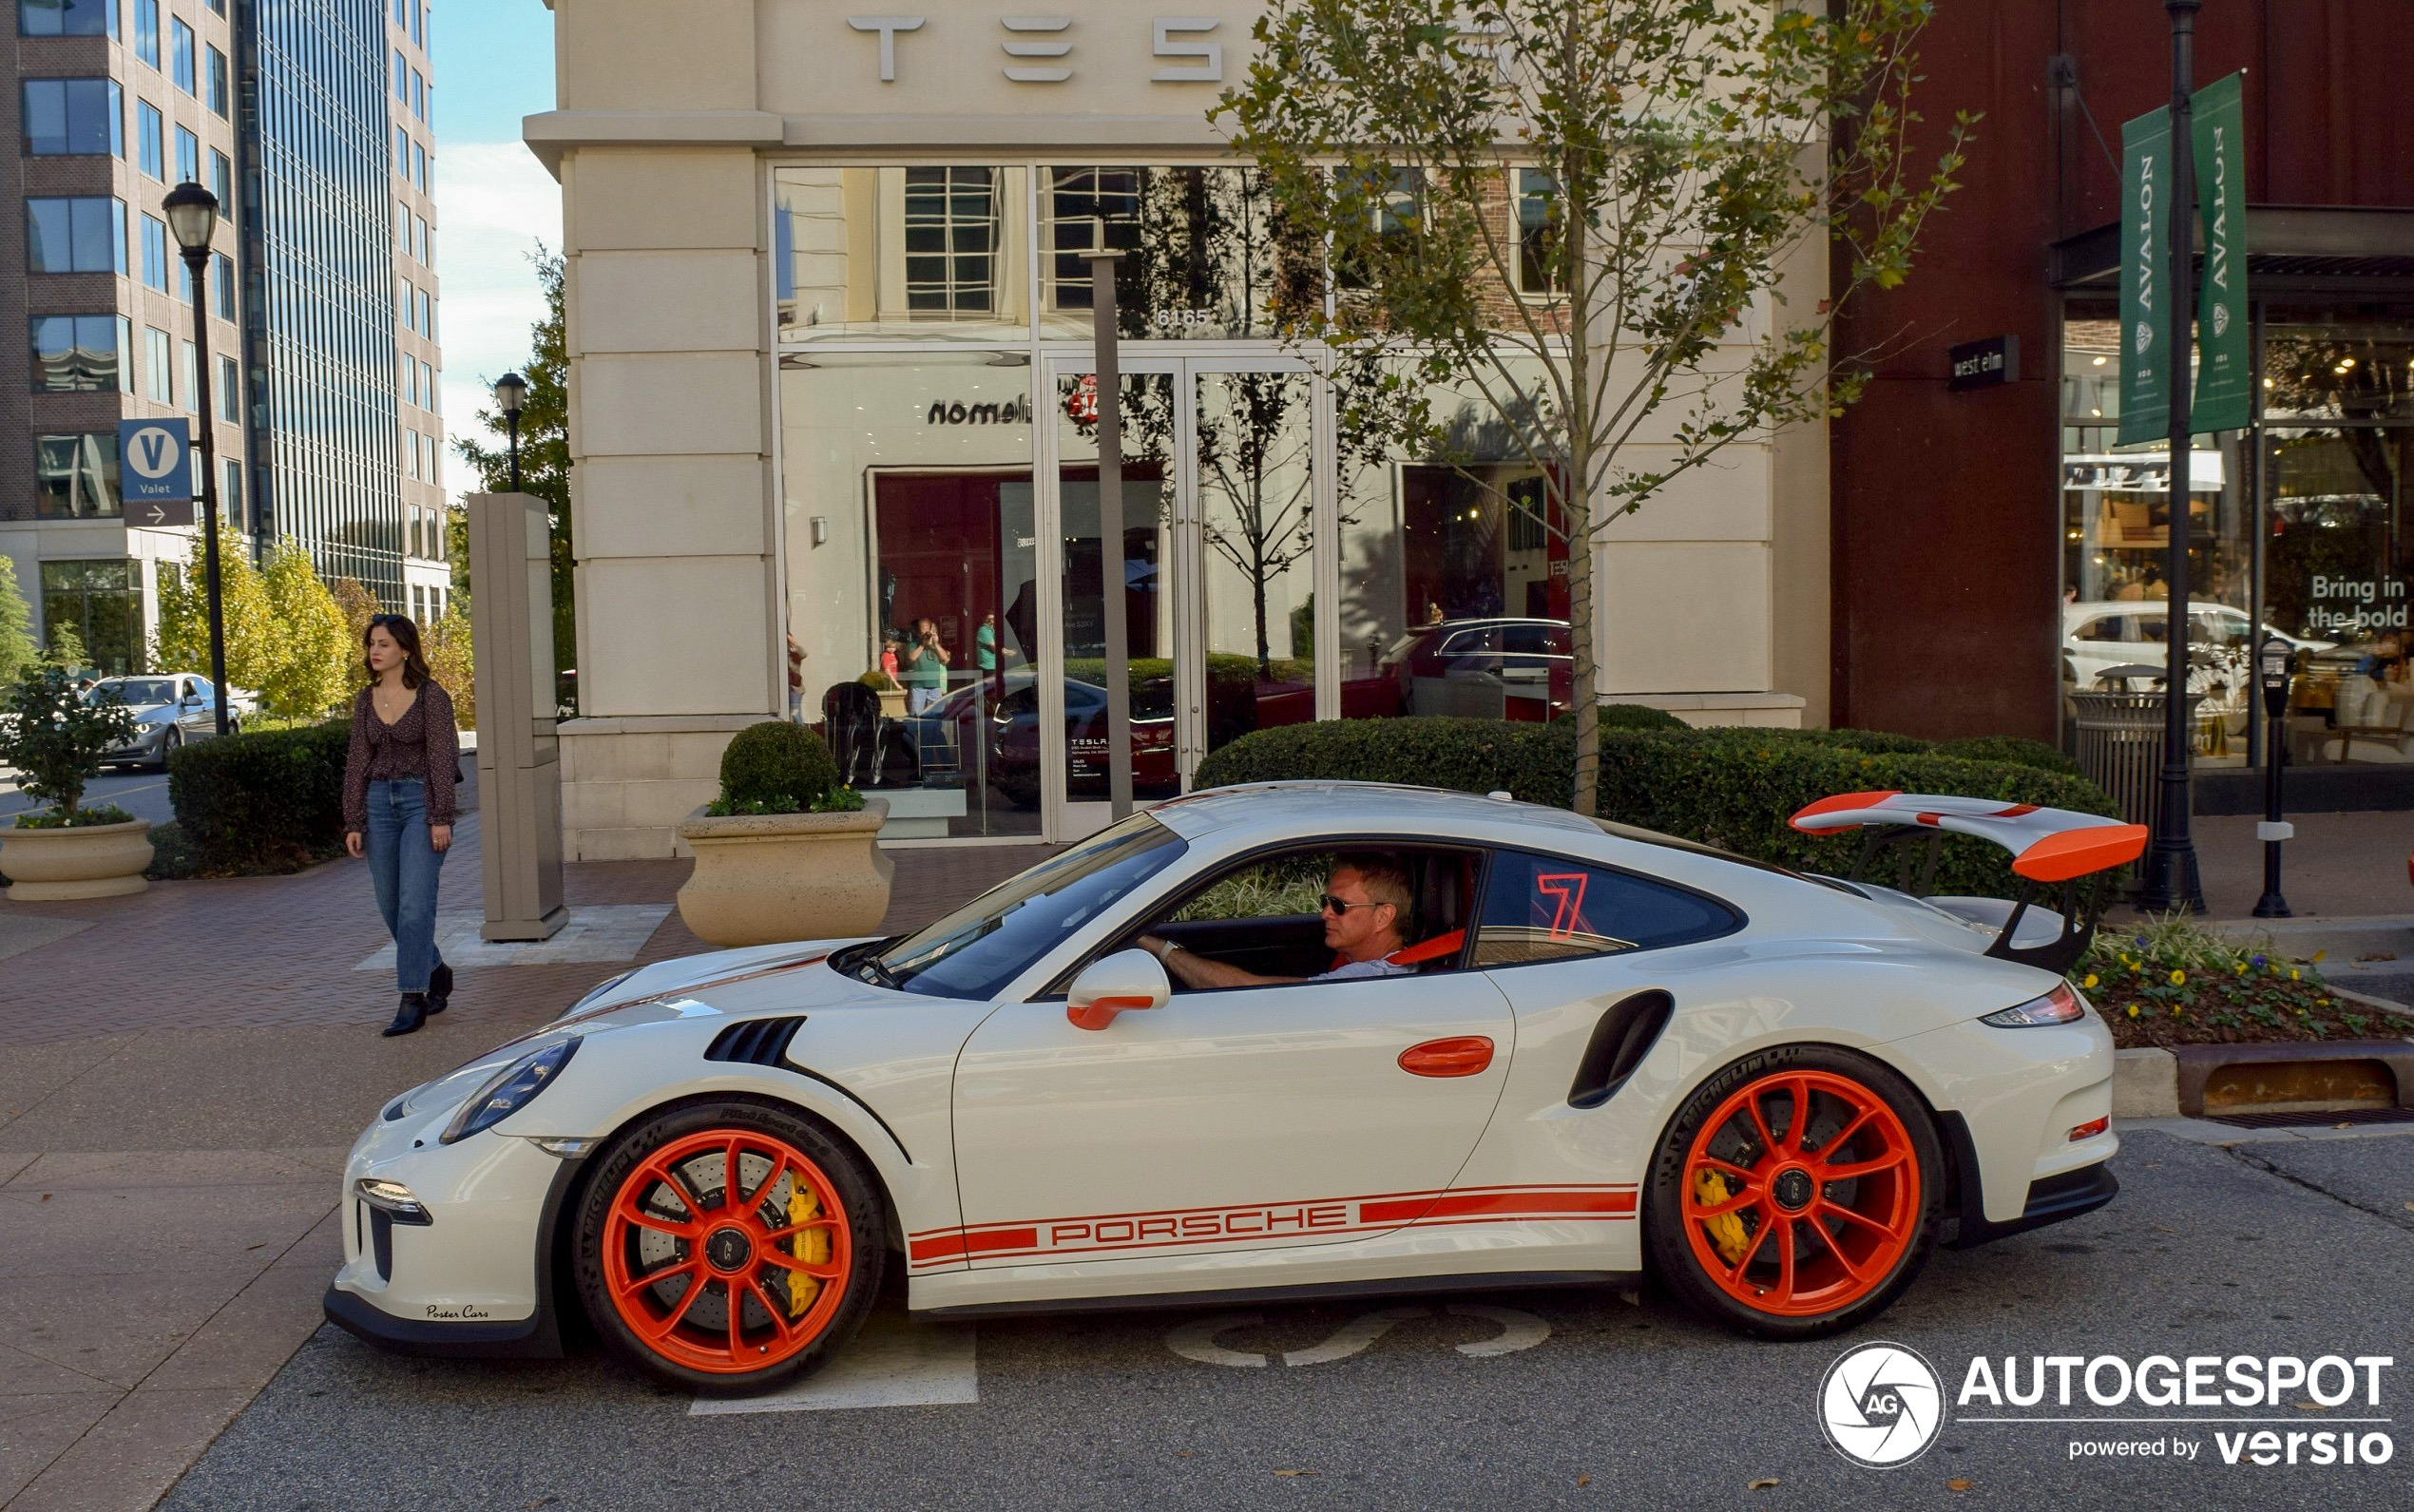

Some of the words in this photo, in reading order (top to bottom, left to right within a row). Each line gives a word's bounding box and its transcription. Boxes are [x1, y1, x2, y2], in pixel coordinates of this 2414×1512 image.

[846, 16, 1514, 84] TESA
[2213, 125, 2227, 292] AVALON
[2139, 155, 2154, 312] AVALON
[1158, 309, 1207, 326] 6165
[1954, 354, 1980, 377] west
[1982, 352, 2002, 372] elm
[140, 434, 165, 470] V
[140, 484, 171, 494] Valet
[2312, 575, 2375, 603] Bring
[2384, 575, 2404, 597] in
[2308, 605, 2347, 627] the
[2355, 604, 2407, 627] bold
[1538, 872, 1587, 941] 7
[1682, 1054, 1766, 1130] MICHELIN
[1051, 1204, 1347, 1246] PORSCHE
[723, 1240, 733, 1261] RS
[426, 1305, 459, 1318] Poster
[462, 1304, 489, 1318] Cars
